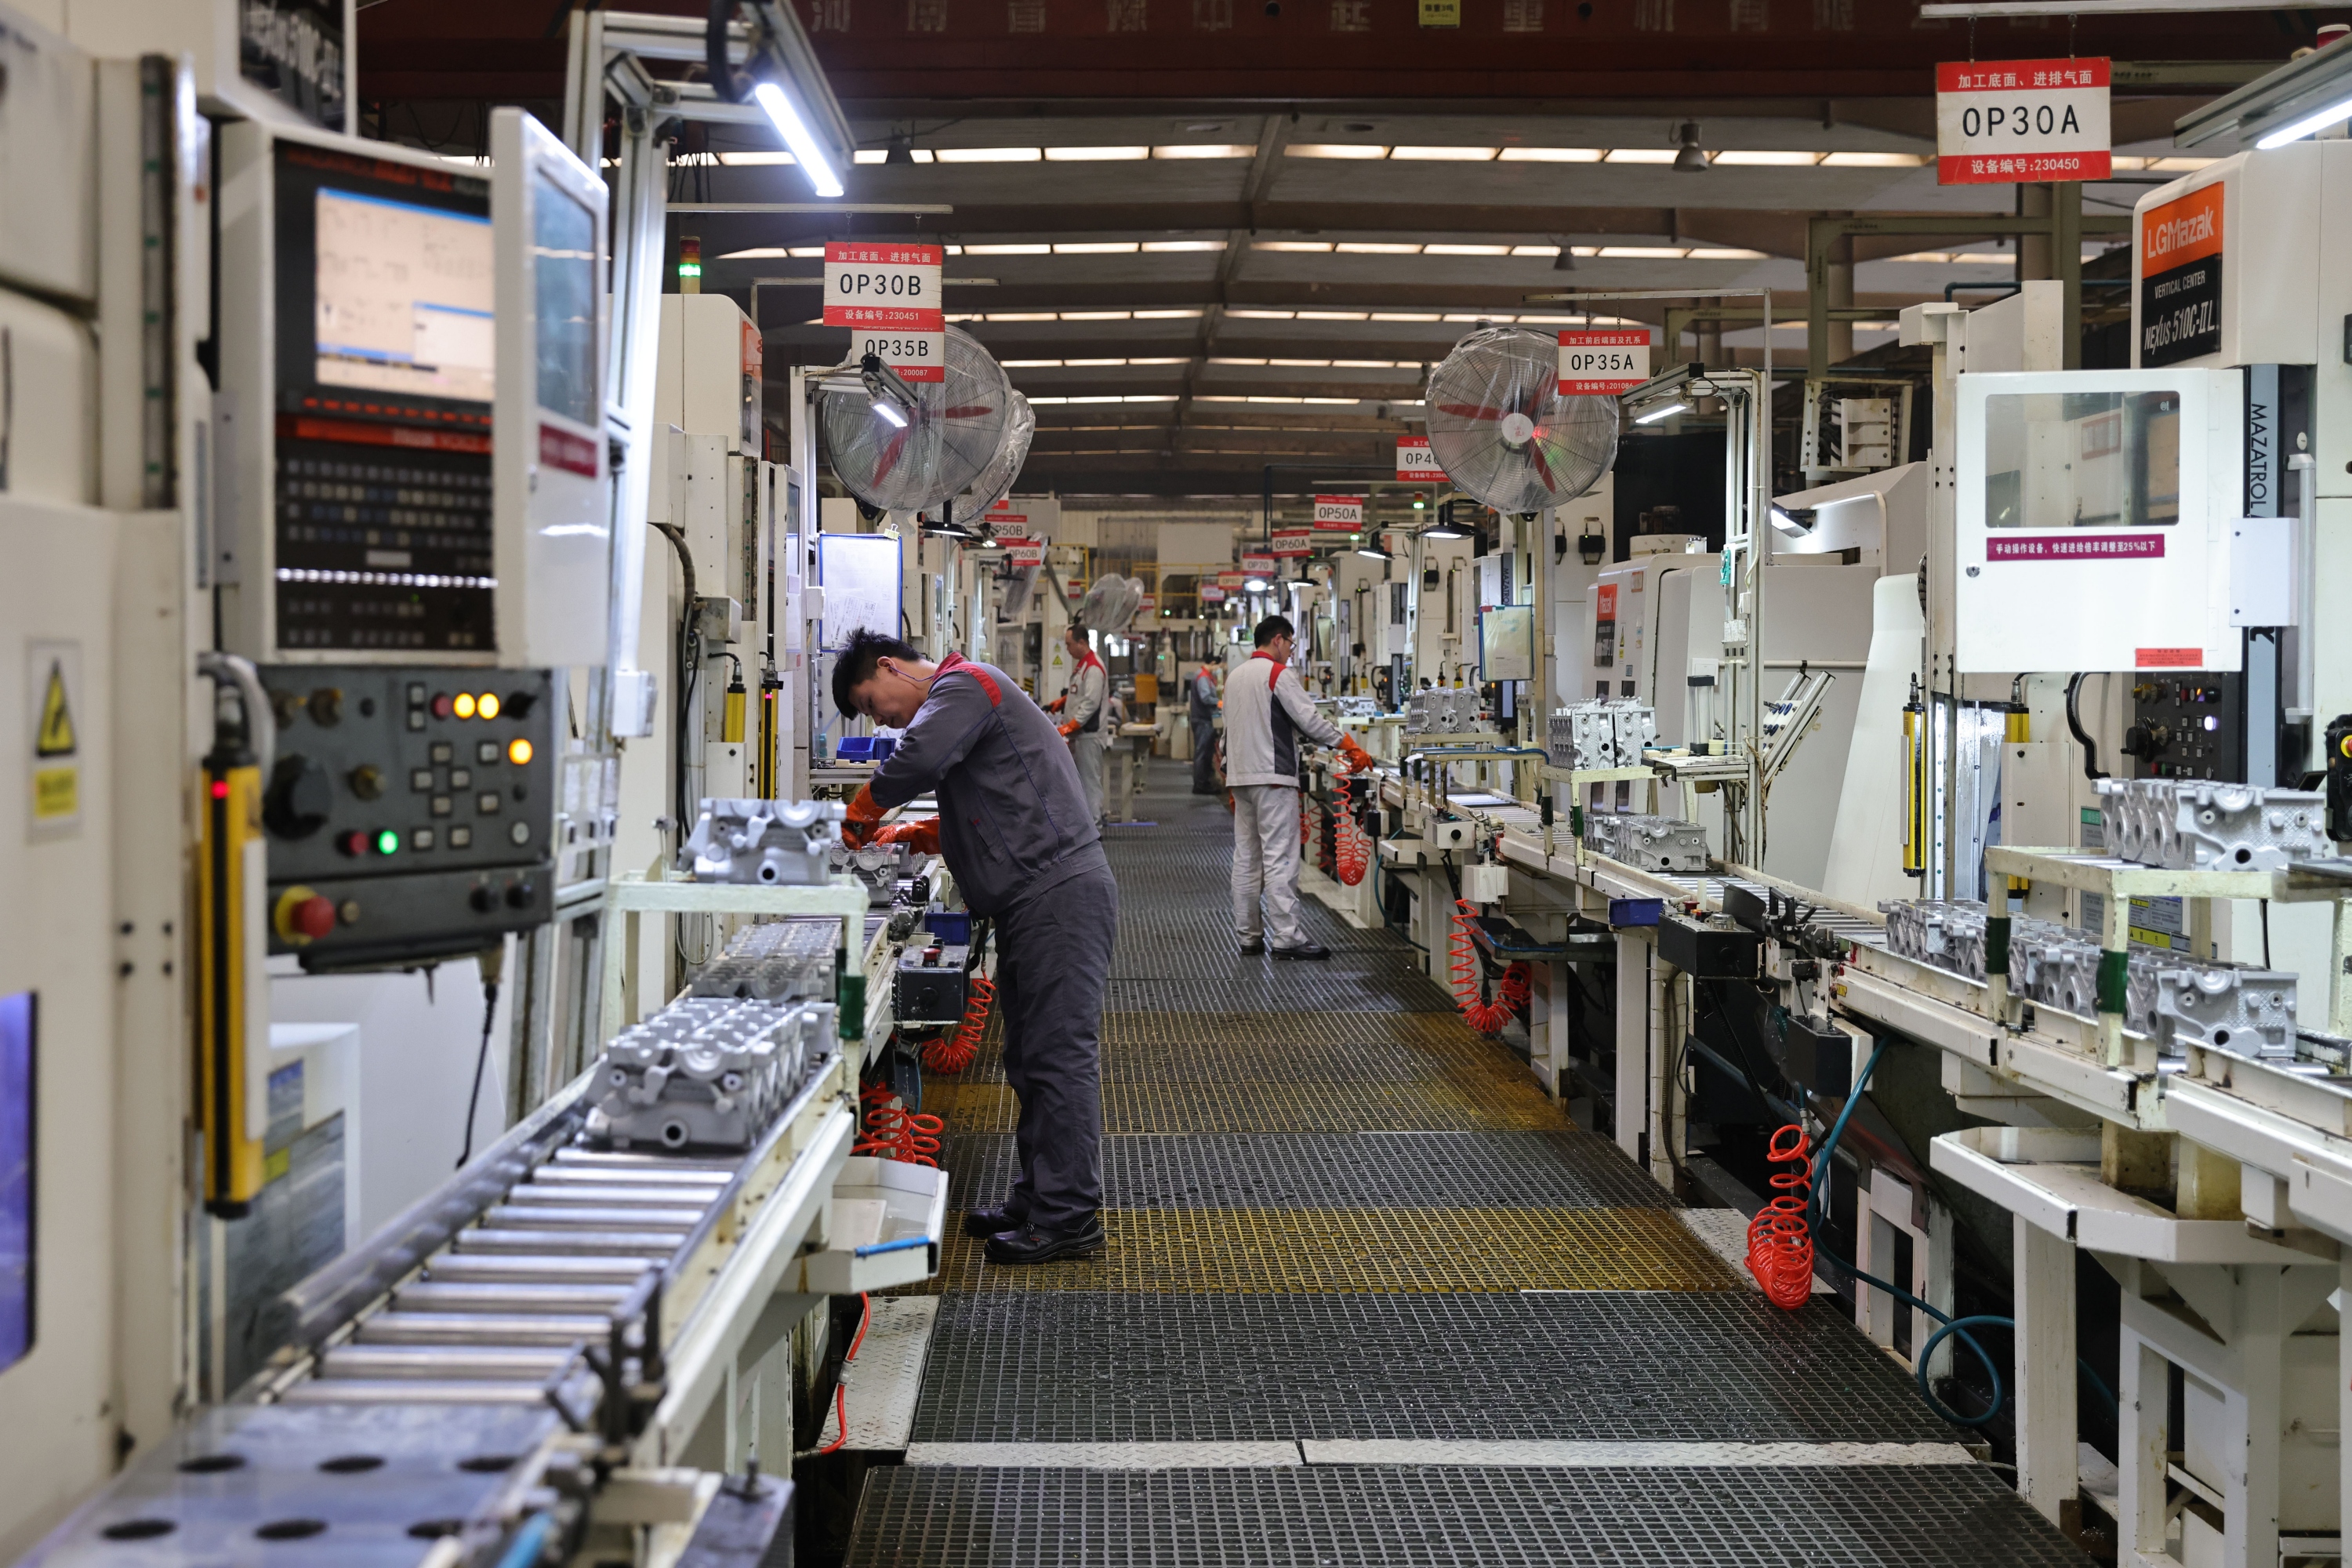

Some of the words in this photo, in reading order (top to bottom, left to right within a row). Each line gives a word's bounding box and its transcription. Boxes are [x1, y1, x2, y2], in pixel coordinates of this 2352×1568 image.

[1958, 70, 2092, 89] 加工底面、进排气面
[1962, 104, 2080, 137] OP30A
[1971, 158, 2080, 174] 设备编号:230450
[2147, 205, 2214, 259] LGMazak
[837, 250, 931, 263] 加工底面、进排气面
[840, 274, 921, 296] OP30B
[2154, 278, 2181, 299] VERTICAL
[2182, 270, 2205, 290] CENTER
[844, 309, 920, 321] 设备编号:230451
[1569, 336, 1641, 345] 加工前后端面及孔系
[2143, 314, 2171, 355] NEXUS
[865, 339, 928, 357] OP35B
[1571, 354, 1634, 370] OP35A
[892, 368, 928, 376] 号:200087
[2250, 403, 2268, 510] MAZATROL
[1319, 506, 1357, 520] OP50A
[995, 524, 1023, 535] P50B
[1276, 539, 1307, 549] OP60A
[1009, 549, 1038, 558] OP60B
